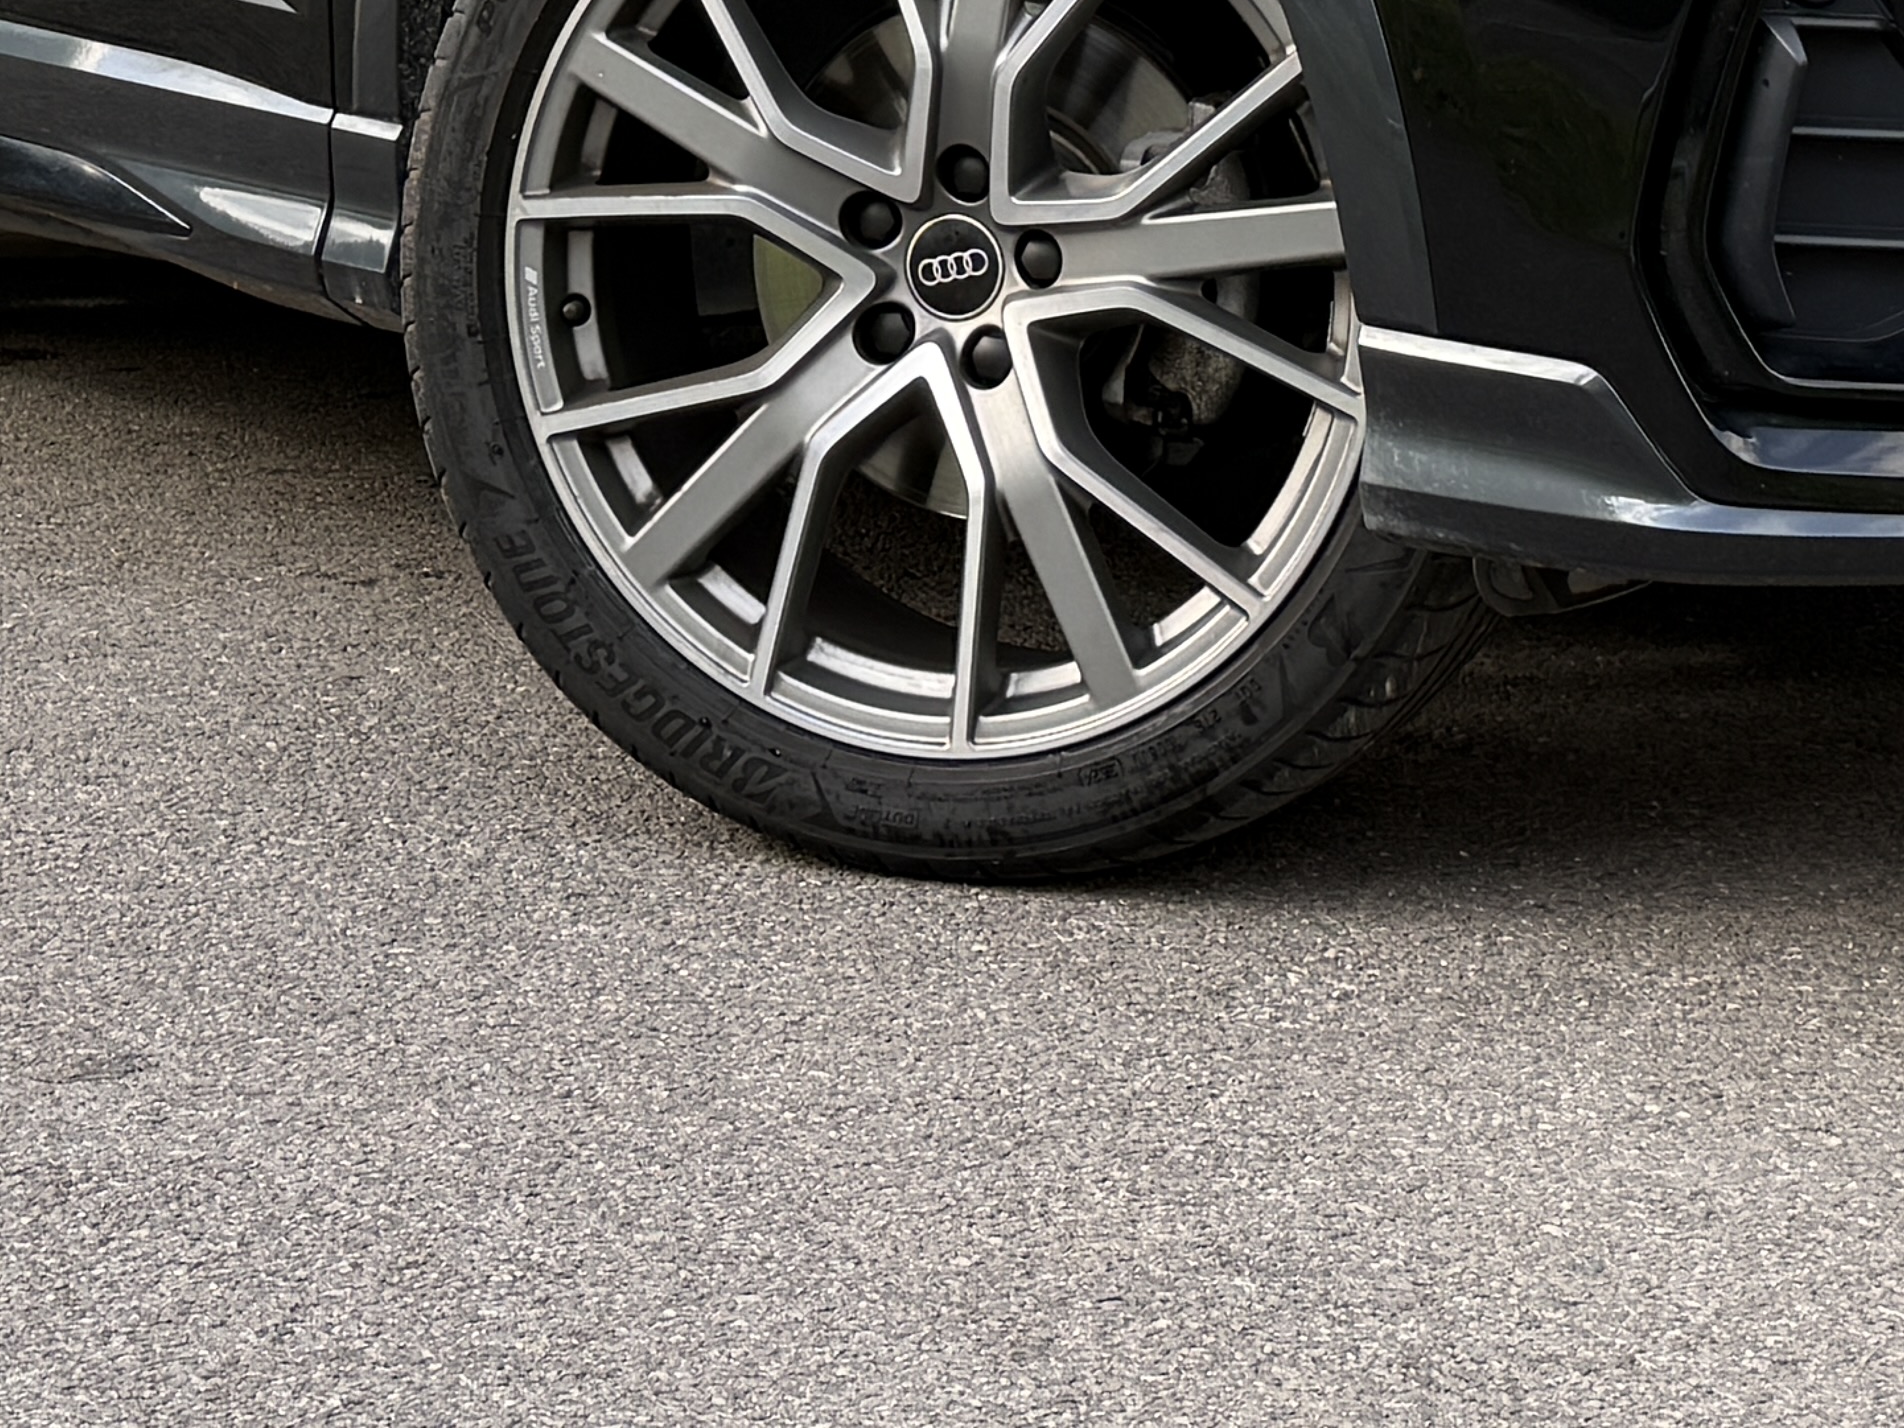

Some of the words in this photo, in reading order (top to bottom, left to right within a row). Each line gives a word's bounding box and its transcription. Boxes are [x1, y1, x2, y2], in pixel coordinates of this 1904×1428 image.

[526, 286, 540, 323] Audi
[529, 324, 546, 370] Sport
[497, 528, 793, 805] BRIDGESTONE
